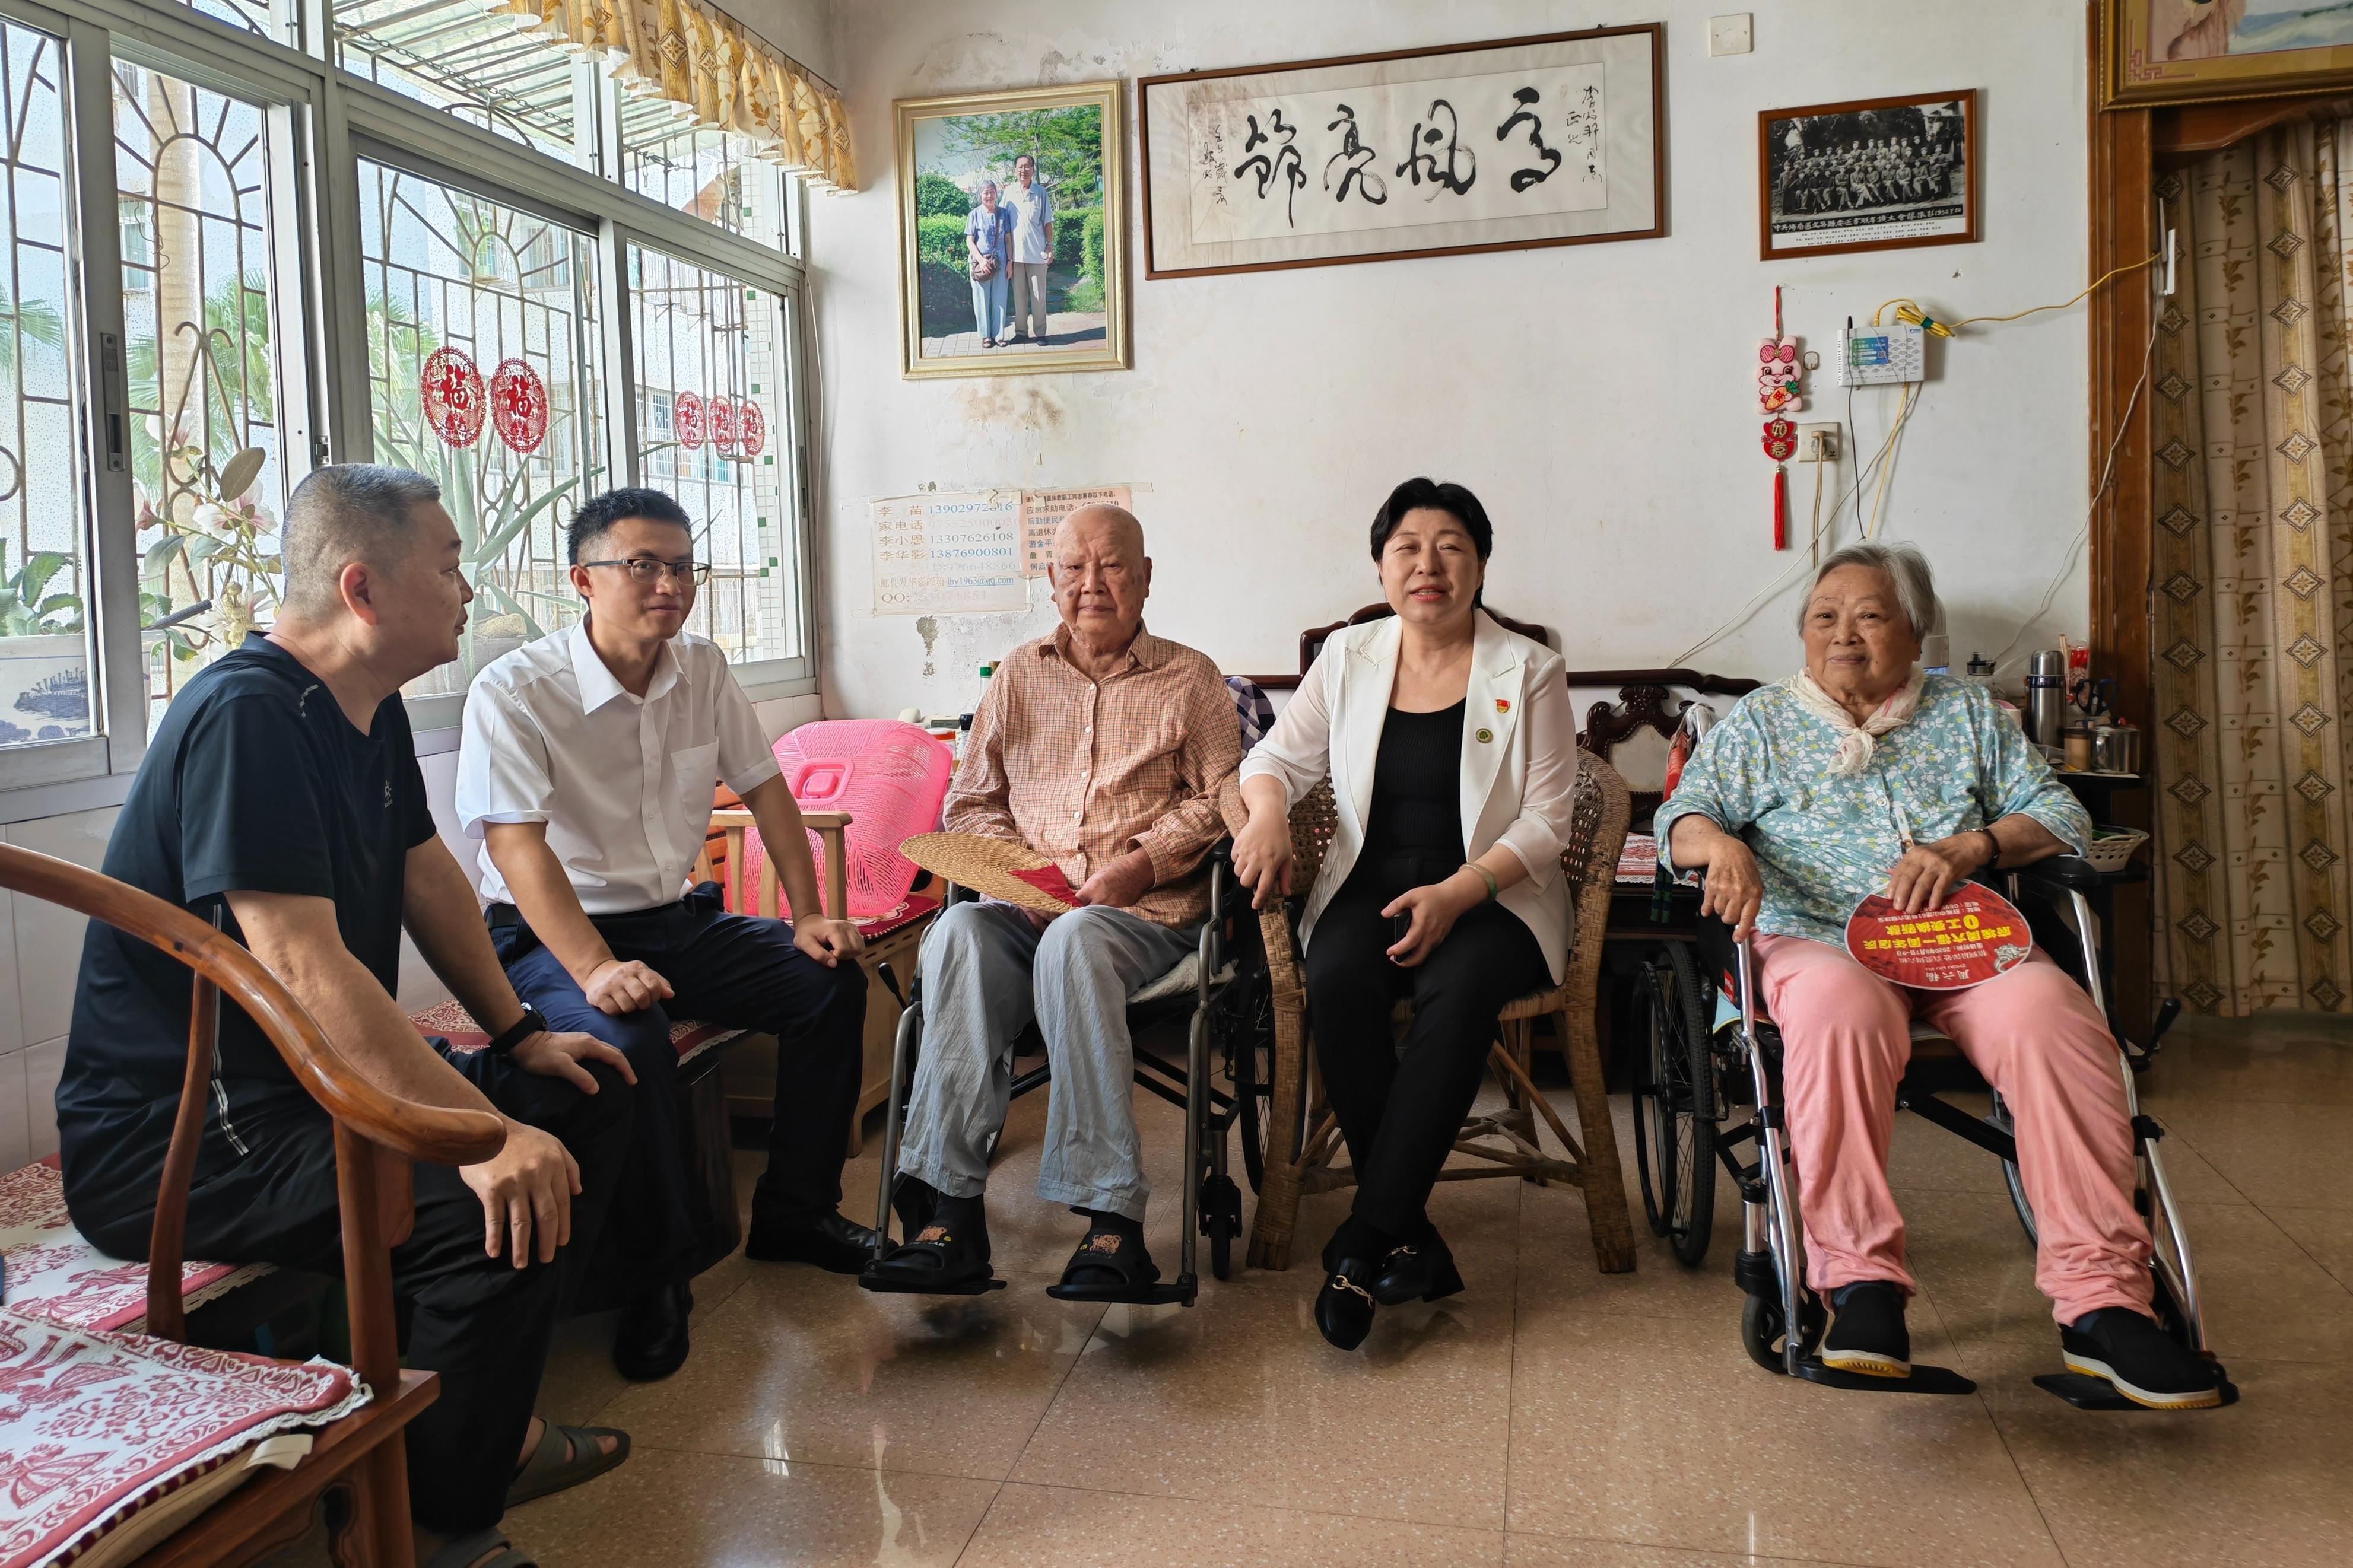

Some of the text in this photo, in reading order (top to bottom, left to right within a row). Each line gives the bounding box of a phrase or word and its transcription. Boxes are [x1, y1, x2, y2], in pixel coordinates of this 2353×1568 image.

[440, 364, 469, 410] 福
[507, 375, 532, 418] 福
[929, 502, 1012, 515] 1390297216
[879, 518, 923, 532] 家电话
[879, 532, 1014, 546] 李小恩 13307626108
[879, 548, 1013, 561] 李华影 13876900801
[1925, 969, 1970, 982] 周六福
